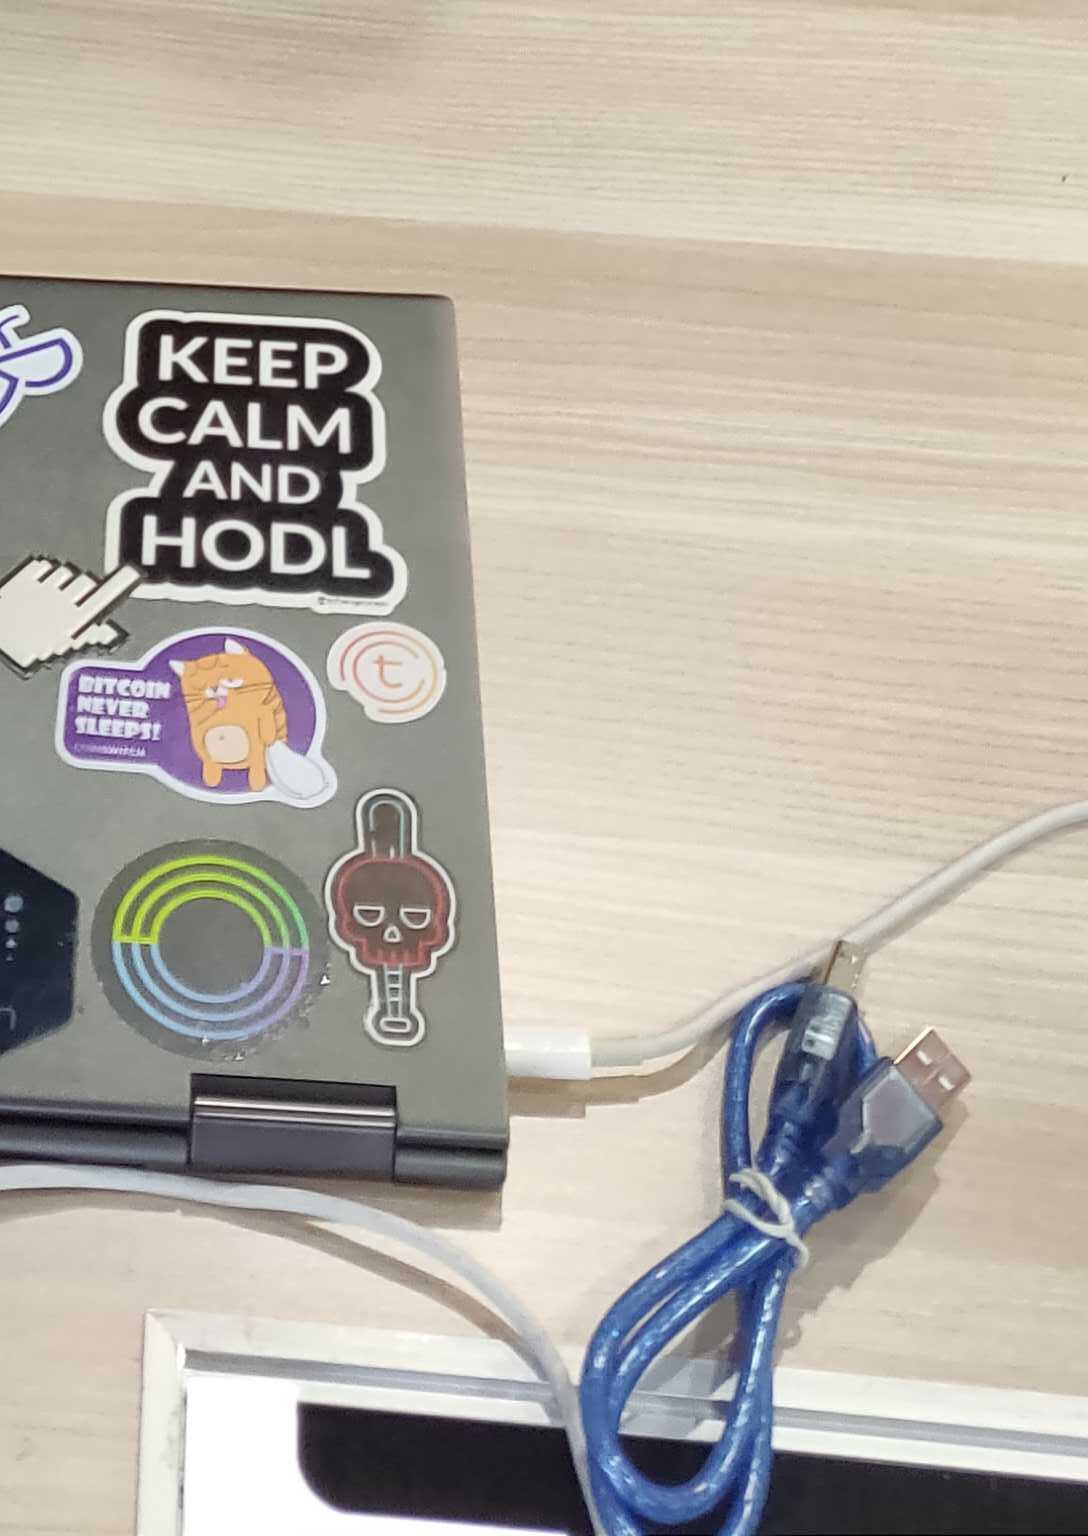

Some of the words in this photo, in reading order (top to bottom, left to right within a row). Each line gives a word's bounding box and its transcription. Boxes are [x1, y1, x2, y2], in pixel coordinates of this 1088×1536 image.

[158, 334, 348, 390] KEEP
[137, 396, 352, 455] CALM
[182, 459, 322, 505] AND
[140, 514, 372, 580] HODL
[77, 695, 149, 719] NEVER
[78, 674, 171, 699] BITCOIN
[75, 715, 161, 741] SLEEPS!
